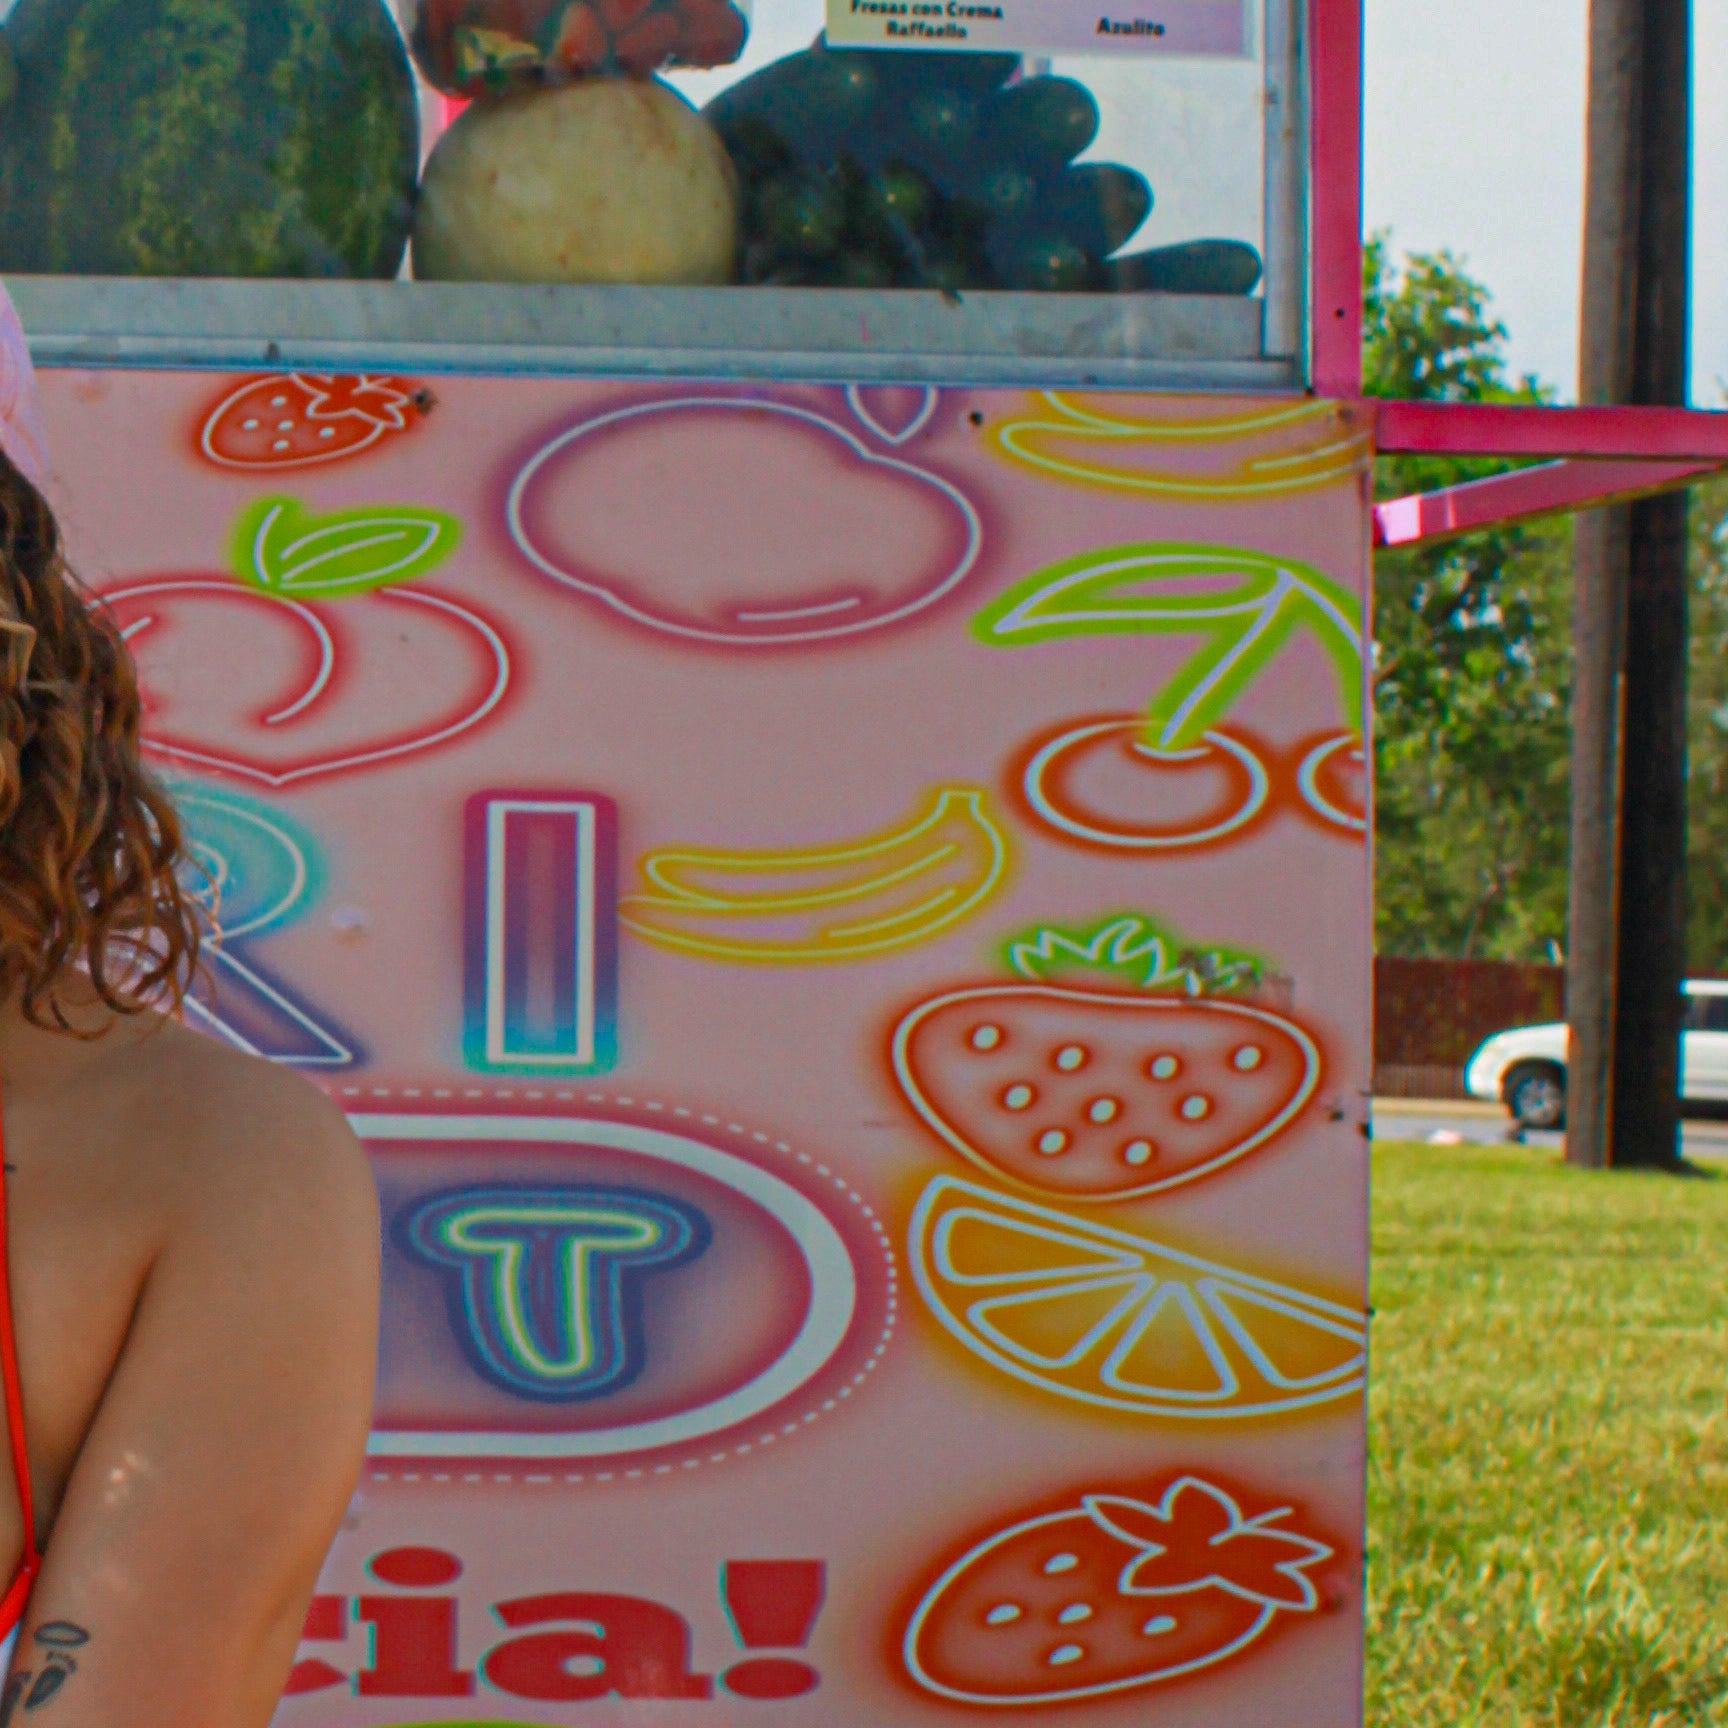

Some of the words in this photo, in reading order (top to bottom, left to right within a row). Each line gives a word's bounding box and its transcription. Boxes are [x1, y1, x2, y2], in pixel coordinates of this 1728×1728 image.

[911, 3, 943, 17] con
[946, 0, 1004, 20] Crema
[1095, 16, 1166, 37] Azulito
